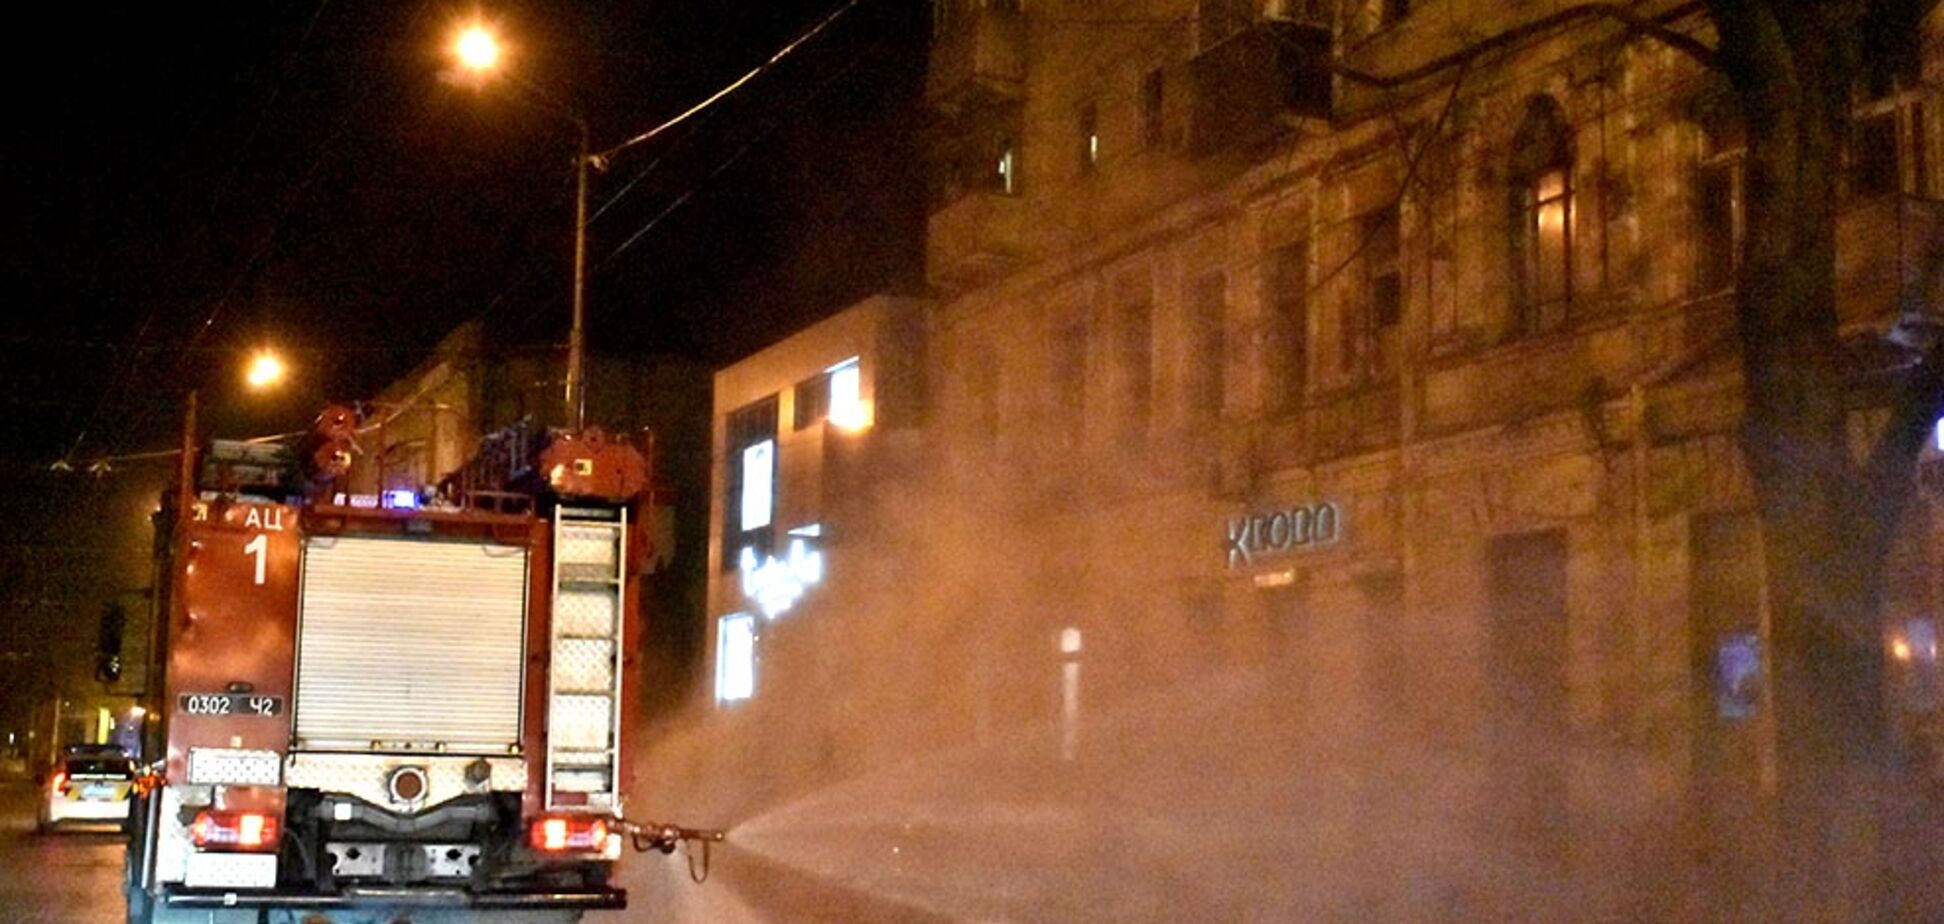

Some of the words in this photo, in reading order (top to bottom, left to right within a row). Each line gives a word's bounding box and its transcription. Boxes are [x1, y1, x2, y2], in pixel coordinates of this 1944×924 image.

[245, 507, 283, 530] АЦ
[244, 534, 267, 584] 1
[188, 695, 230, 714] 0302
